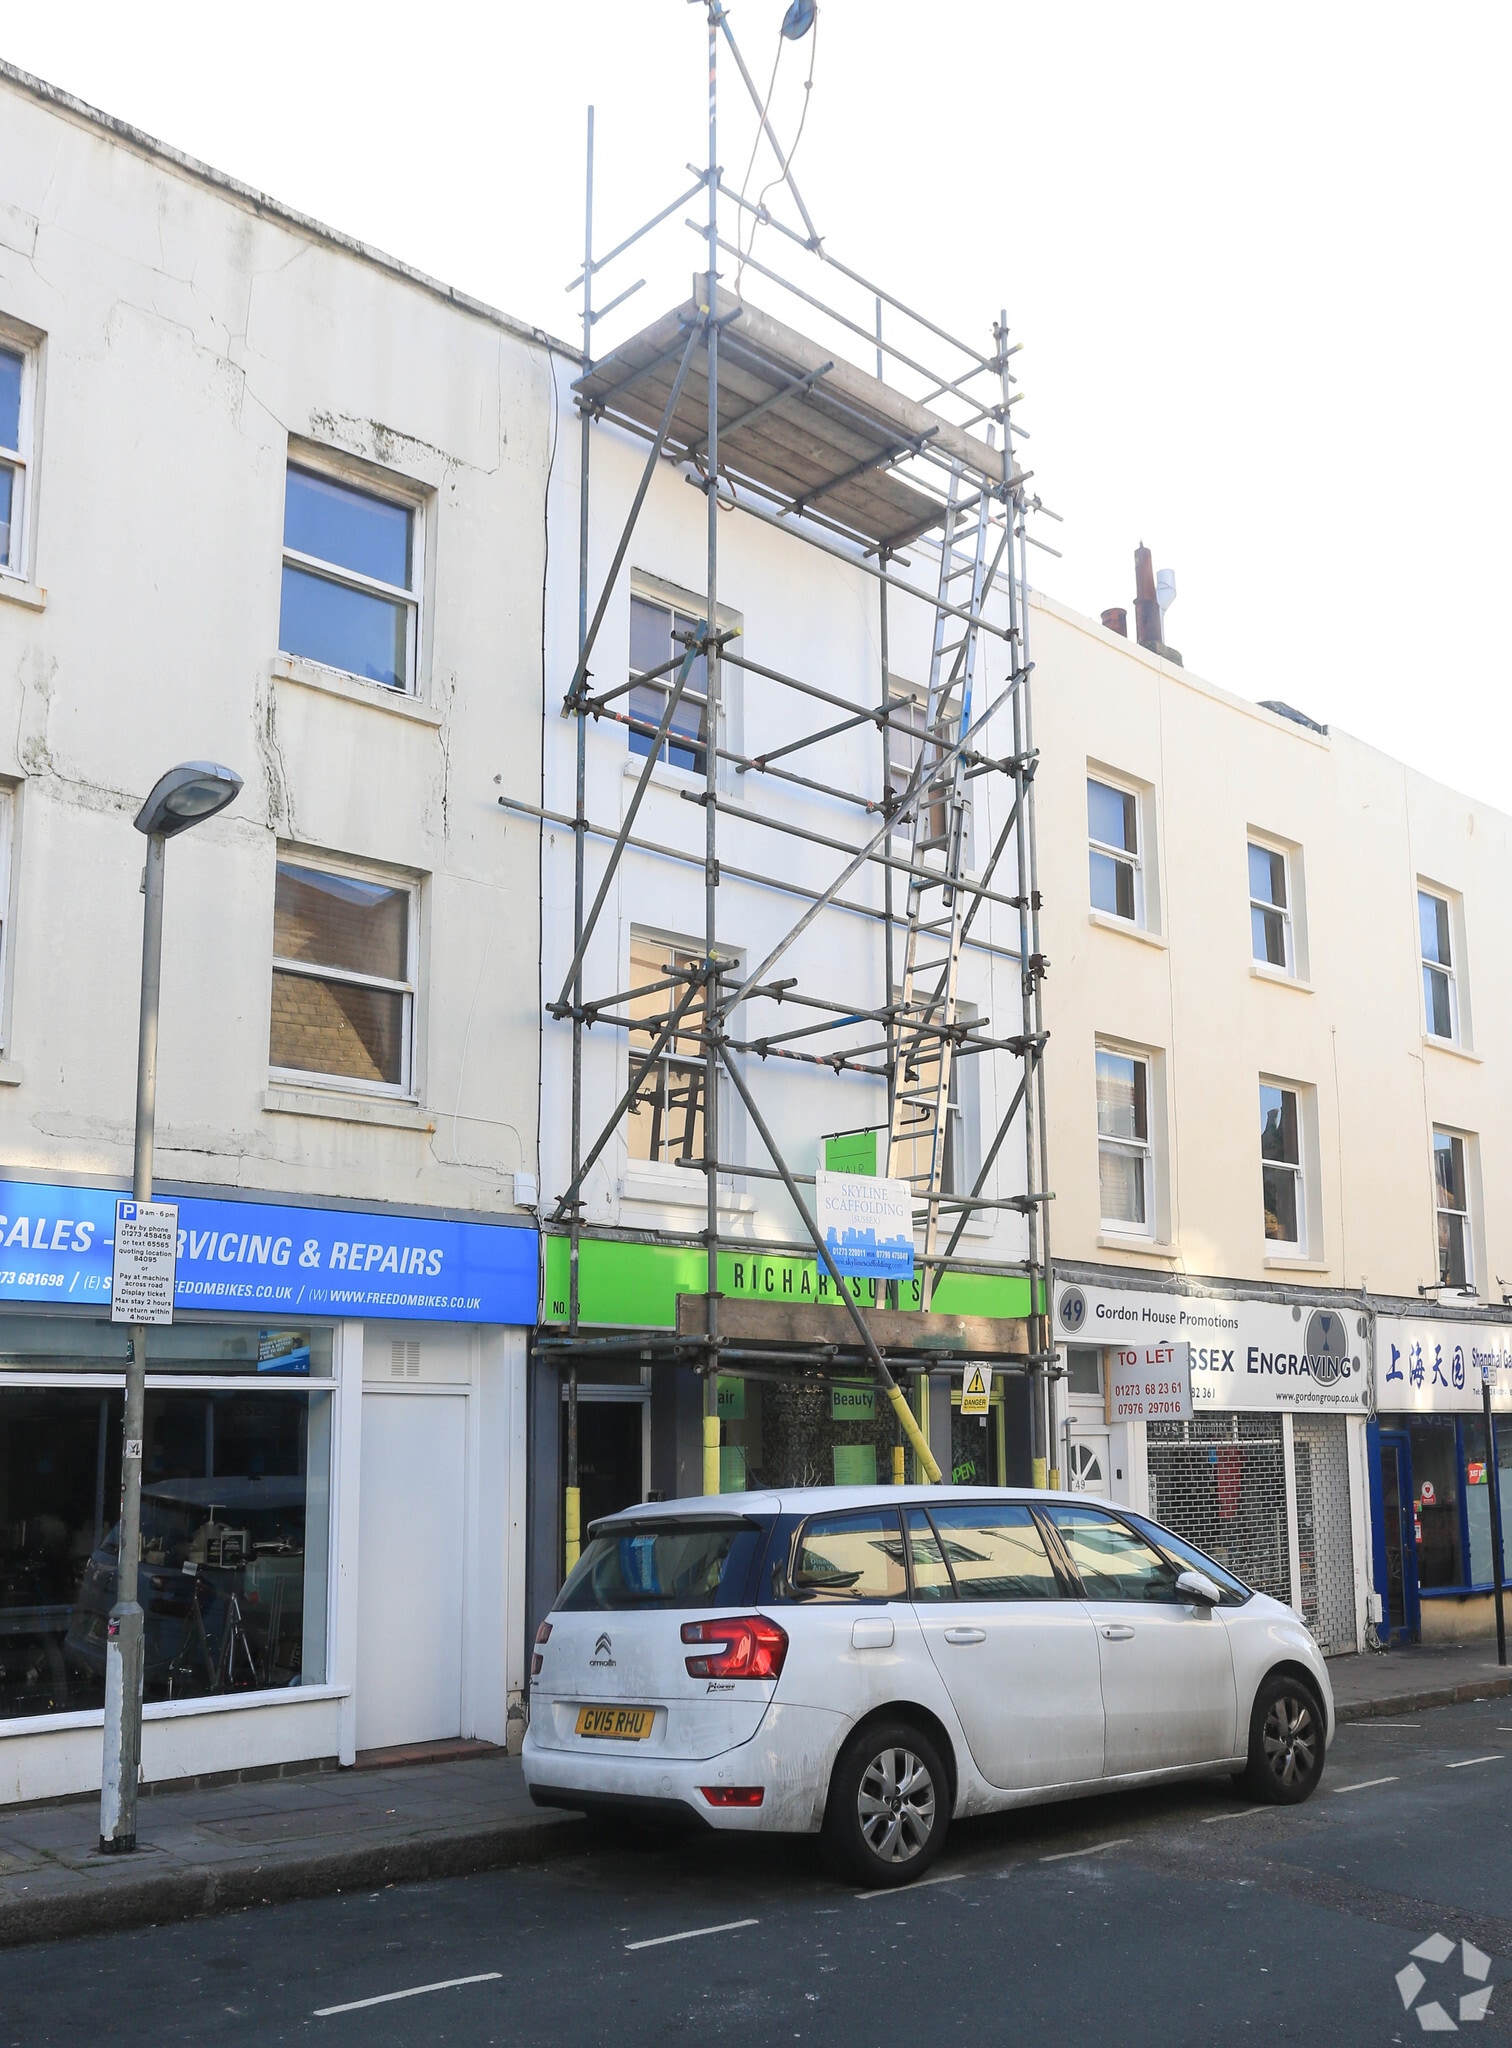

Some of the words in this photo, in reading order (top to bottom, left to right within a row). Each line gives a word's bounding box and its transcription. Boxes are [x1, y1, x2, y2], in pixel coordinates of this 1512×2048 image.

[841, 1184, 888, 1200] SKYLINE
[123, 1204, 135, 1219] P
[825, 1197, 904, 1216] SCAFFOLDING
[851, 1215, 881, 1225] (SUSSEX)
[124, 1223, 137, 1232] Pay
[139, 1224, 147, 1232] by
[148, 1226, 169, 1234] phone
[143, 1232, 172, 1240] 458458
[118, 1248, 144, 1256] quoting
[145, 1249, 172, 1257] location
[176, 1229, 292, 1266] RVICING
[298, 1239, 320, 1268] &
[329, 1241, 444, 1276] REPAIRS
[119, 1272, 132, 1280] Pay
[142, 1274, 170, 1282] machine
[734, 1263, 920, 1301] RICHARSON'S
[0, 1271, 16, 1285] 73
[17, 1271, 64, 1287] 681698
[84, 1273, 100, 1290] (E)
[308, 1289, 328, 1302] (W)
[330, 1290, 481, 1309] WWW.FREEDOMBIKES.CO.UK
[121, 1289, 146, 1297] Display
[115, 1296, 129, 1304] Max
[130, 1298, 145, 1306] stay
[553, 1300, 567, 1315] NO.
[1063, 1299, 1083, 1321] 49
[1096, 1303, 1138, 1321] Gordon
[1142, 1307, 1176, 1324] House
[1179, 1311, 1239, 1329] Promotions
[1117, 1351, 1137, 1366] TO
[1145, 1348, 1175, 1364] LET
[1115, 1384, 1141, 1396] 01273
[1145, 1383, 1156, 1395] 68
[1158, 1382, 1170, 1394] 23
[1171, 1382, 1182, 1393] 61
[1203, 1387, 1215, 1398] 361
[718, 1390, 734, 1404] air
[833, 1392, 874, 1408] Beauty
[964, 1398, 986, 1406] DANGER
[1275, 1391, 1359, 1405] www.gordongroup.co.uk
[1118, 1403, 1144, 1415] 07976
[1148, 1401, 1181, 1414] 297016
[1075, 1480, 1086, 1490] 49
[584, 1710, 615, 1731] GV15
[616, 1712, 645, 1734] RHU
